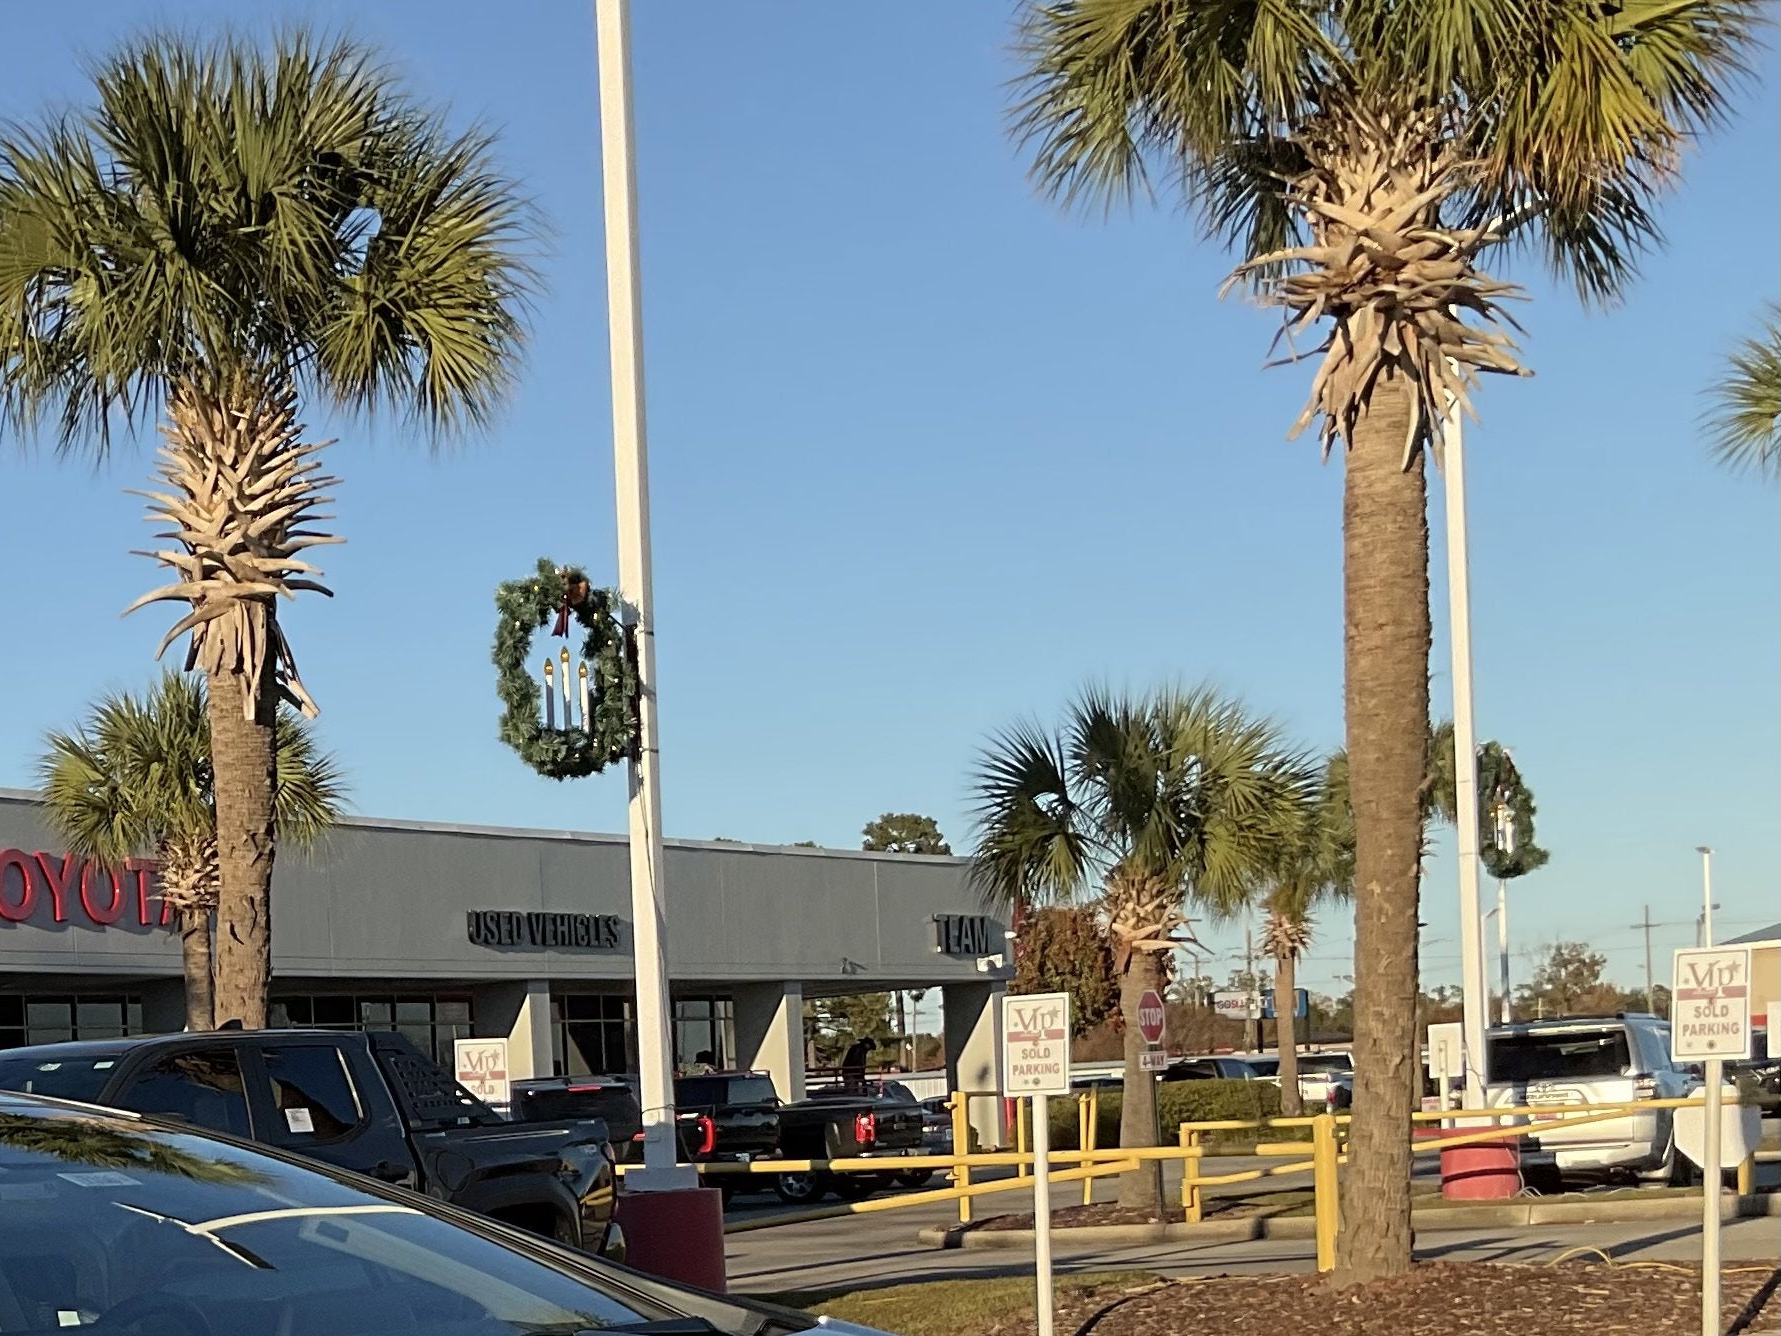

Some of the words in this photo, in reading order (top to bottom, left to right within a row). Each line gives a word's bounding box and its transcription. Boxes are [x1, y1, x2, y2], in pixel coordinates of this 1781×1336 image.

[467, 910, 523, 945] USED
[527, 912, 620, 948] VEHICLES
[933, 913, 991, 954] TEAM
[1139, 1007, 1163, 1027] STOP
[1694, 1005, 1729, 1019] SOLD
[1682, 1022, 1740, 1037] PARKING
[1022, 1047, 1051, 1060] SOLD
[1142, 1055, 1165, 1068] 4-WAY
[1012, 1063, 1060, 1076] PARKING
